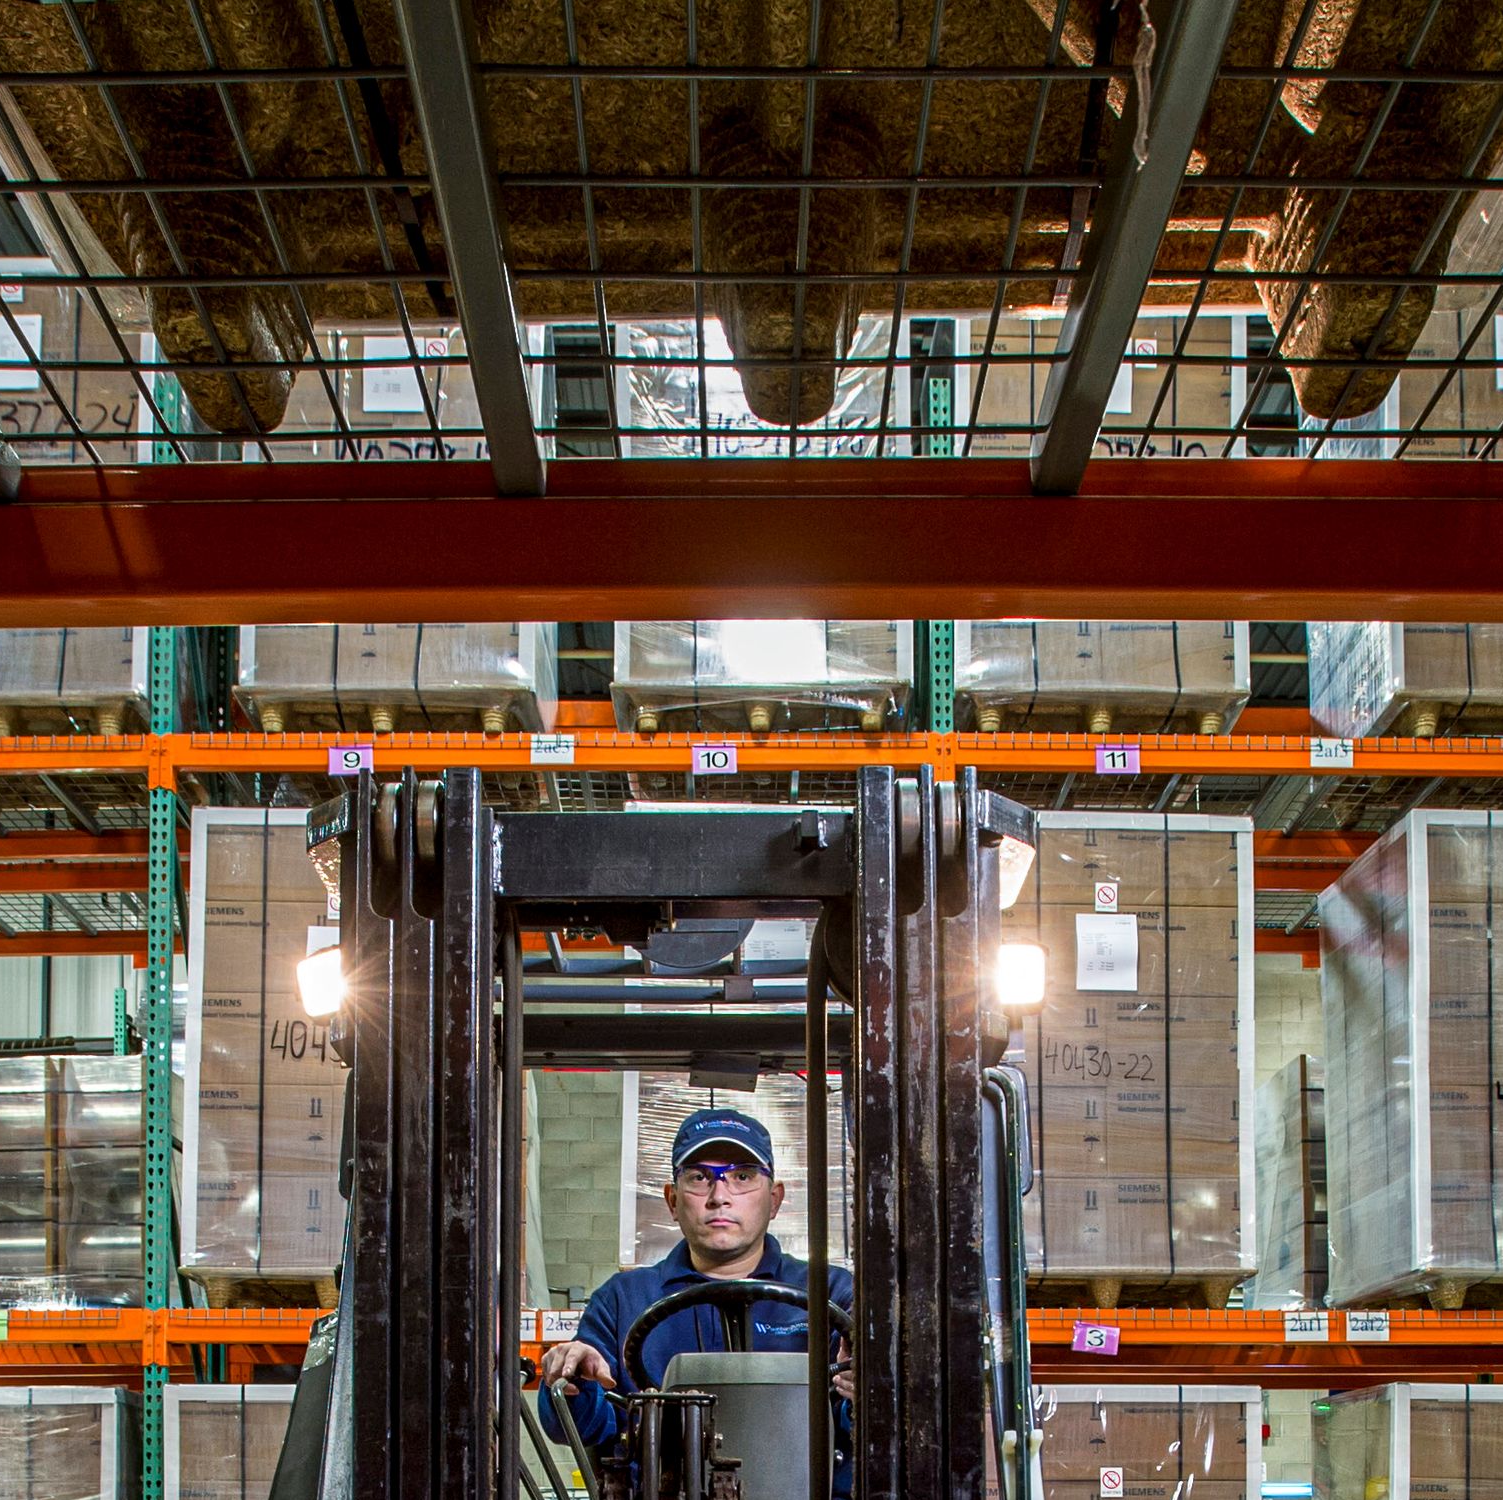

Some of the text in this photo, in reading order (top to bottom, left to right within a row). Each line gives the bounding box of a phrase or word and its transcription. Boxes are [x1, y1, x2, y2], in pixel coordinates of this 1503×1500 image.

[343, 752, 361, 768] 9
[700, 752, 729, 768] 10
[1105, 752, 1128, 769] 11
[206, 907, 244, 916] IEMENS
[1430, 909, 1467, 917] IEMENS
[1430, 1000, 1468, 1008] IEMENS
[1045, 1037, 1156, 1082] 40430-22
[1117, 1093, 1160, 1101] SIEMENS
[1118, 1184, 1161, 1192] SIEMENS
[545, 1316, 576, 1331] 2ae
[1087, 1329, 1105, 1347] 3
[1122, 1487, 1166, 1496] SIEMENS
[1410, 1484, 1448, 1492] IEMENS
